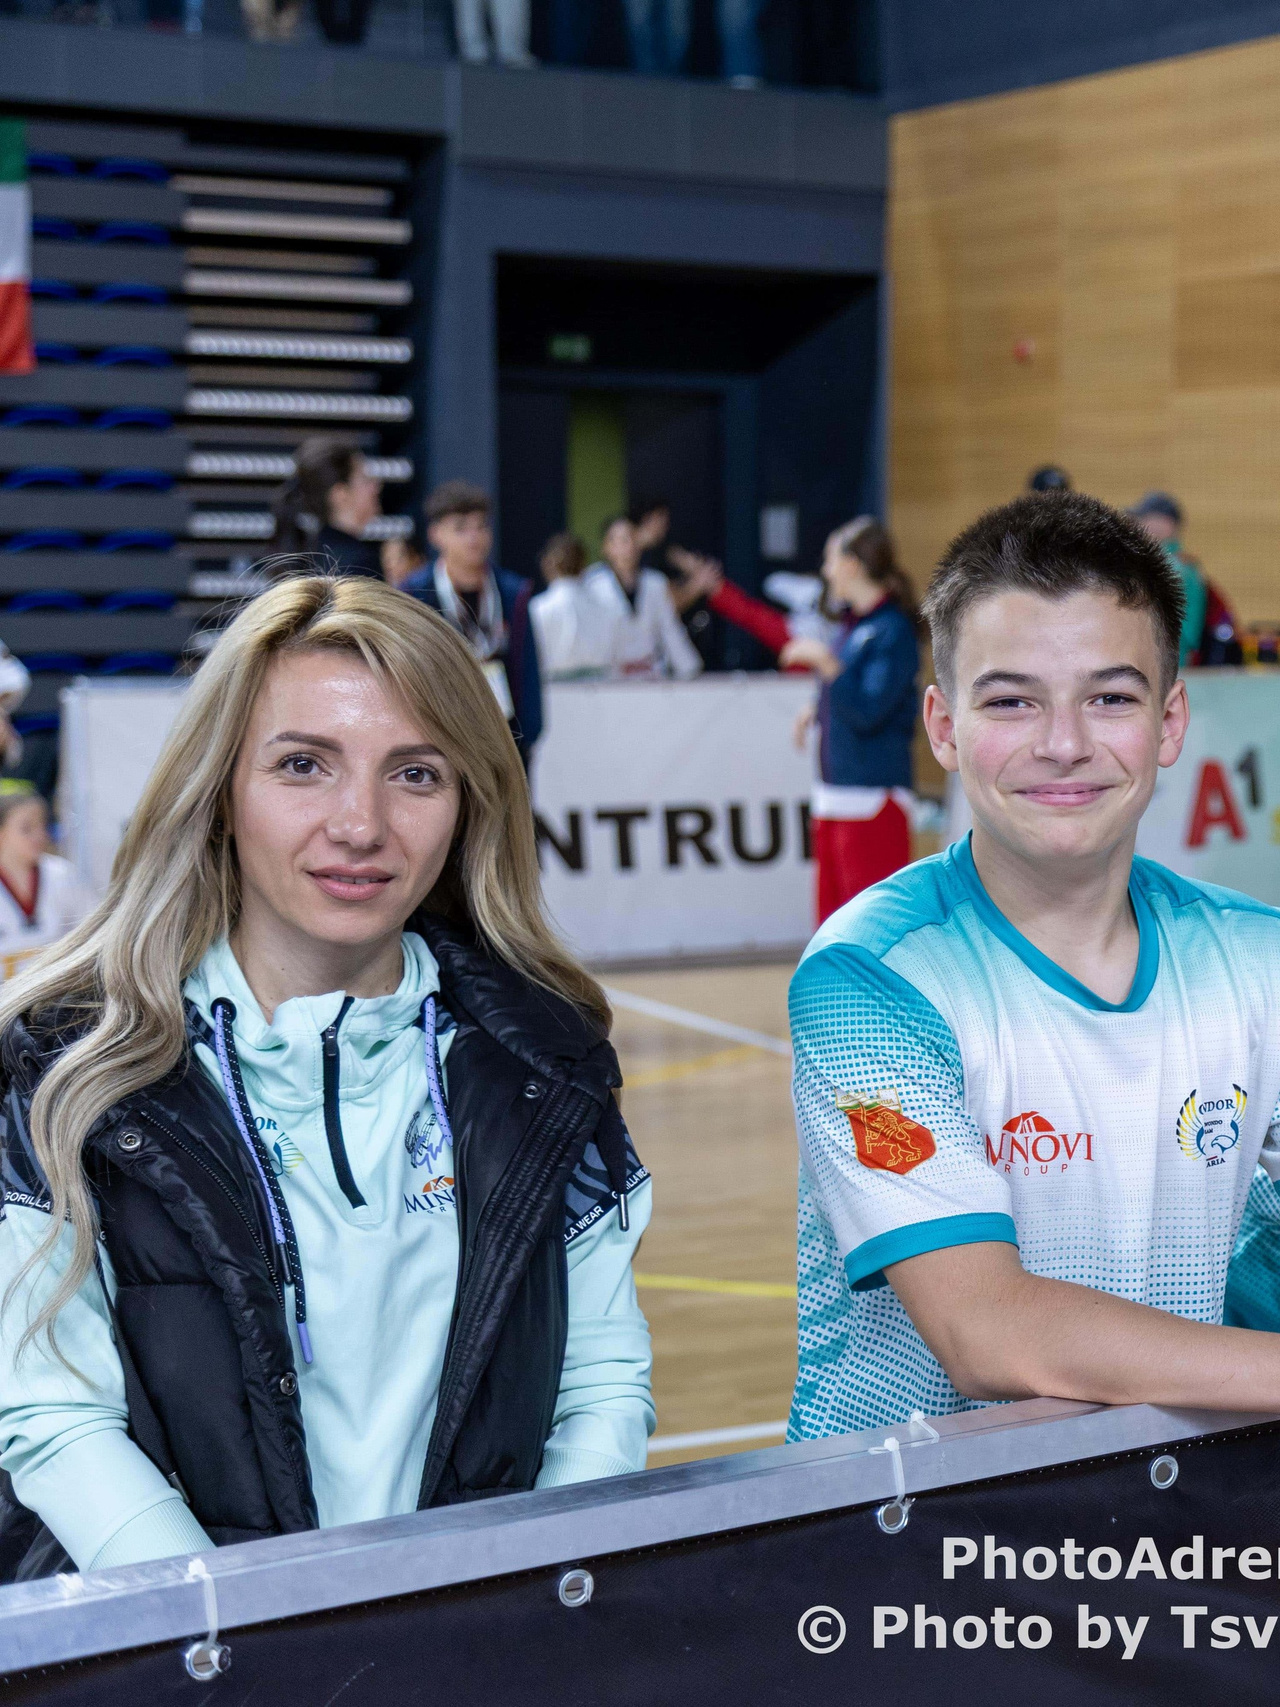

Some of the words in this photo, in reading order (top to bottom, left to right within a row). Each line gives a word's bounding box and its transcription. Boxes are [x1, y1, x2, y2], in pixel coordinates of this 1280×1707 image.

[534, 799, 812, 872] NTRU
[404, 1189, 455, 1214] MIN
[576, 1205, 604, 1230] WEAR
